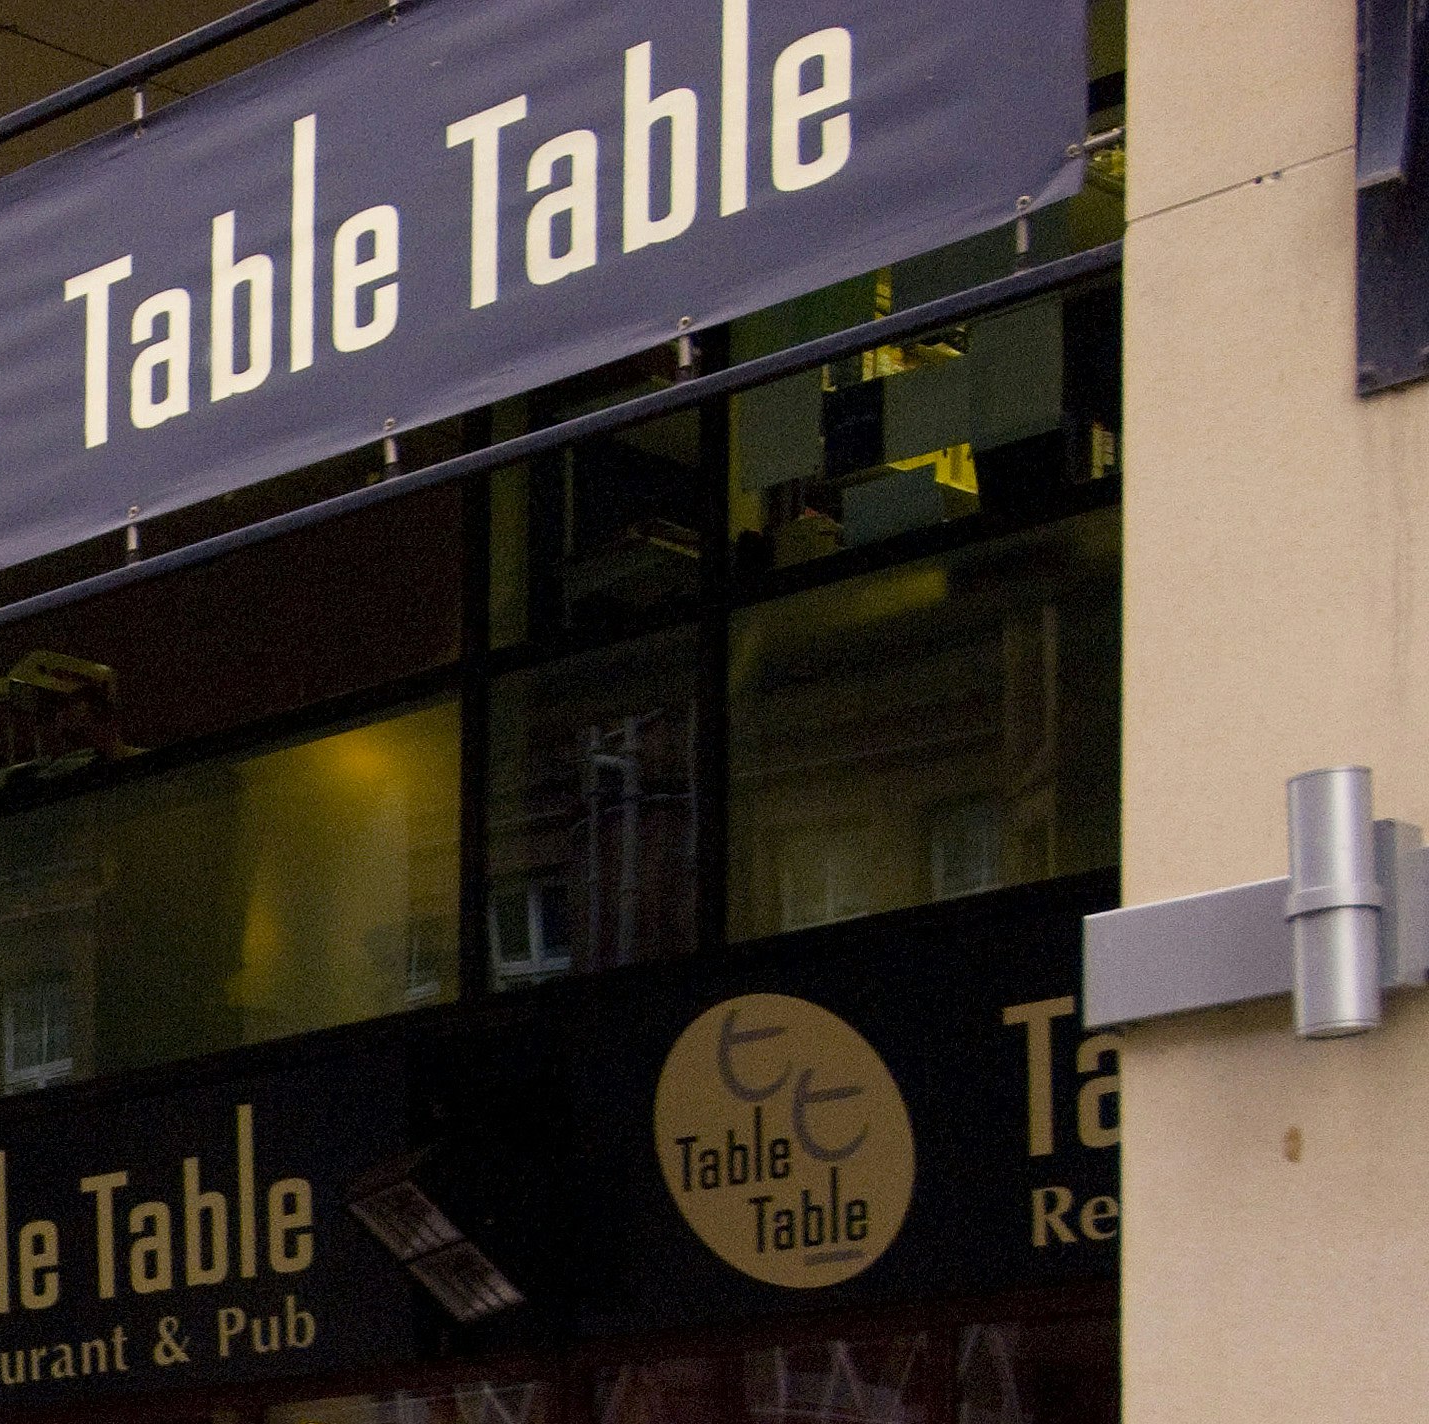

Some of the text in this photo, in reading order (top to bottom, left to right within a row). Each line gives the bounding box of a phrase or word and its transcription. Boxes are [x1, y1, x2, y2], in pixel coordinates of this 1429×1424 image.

[64, 0, 852, 449] Table Table
[676, 1106, 791, 1192] Table
[80, 1104, 314, 1300] Table
[748, 1167, 868, 1253] Table
[154, 1315, 190, 1366] &
[218, 1295, 316, 1358] Pub
